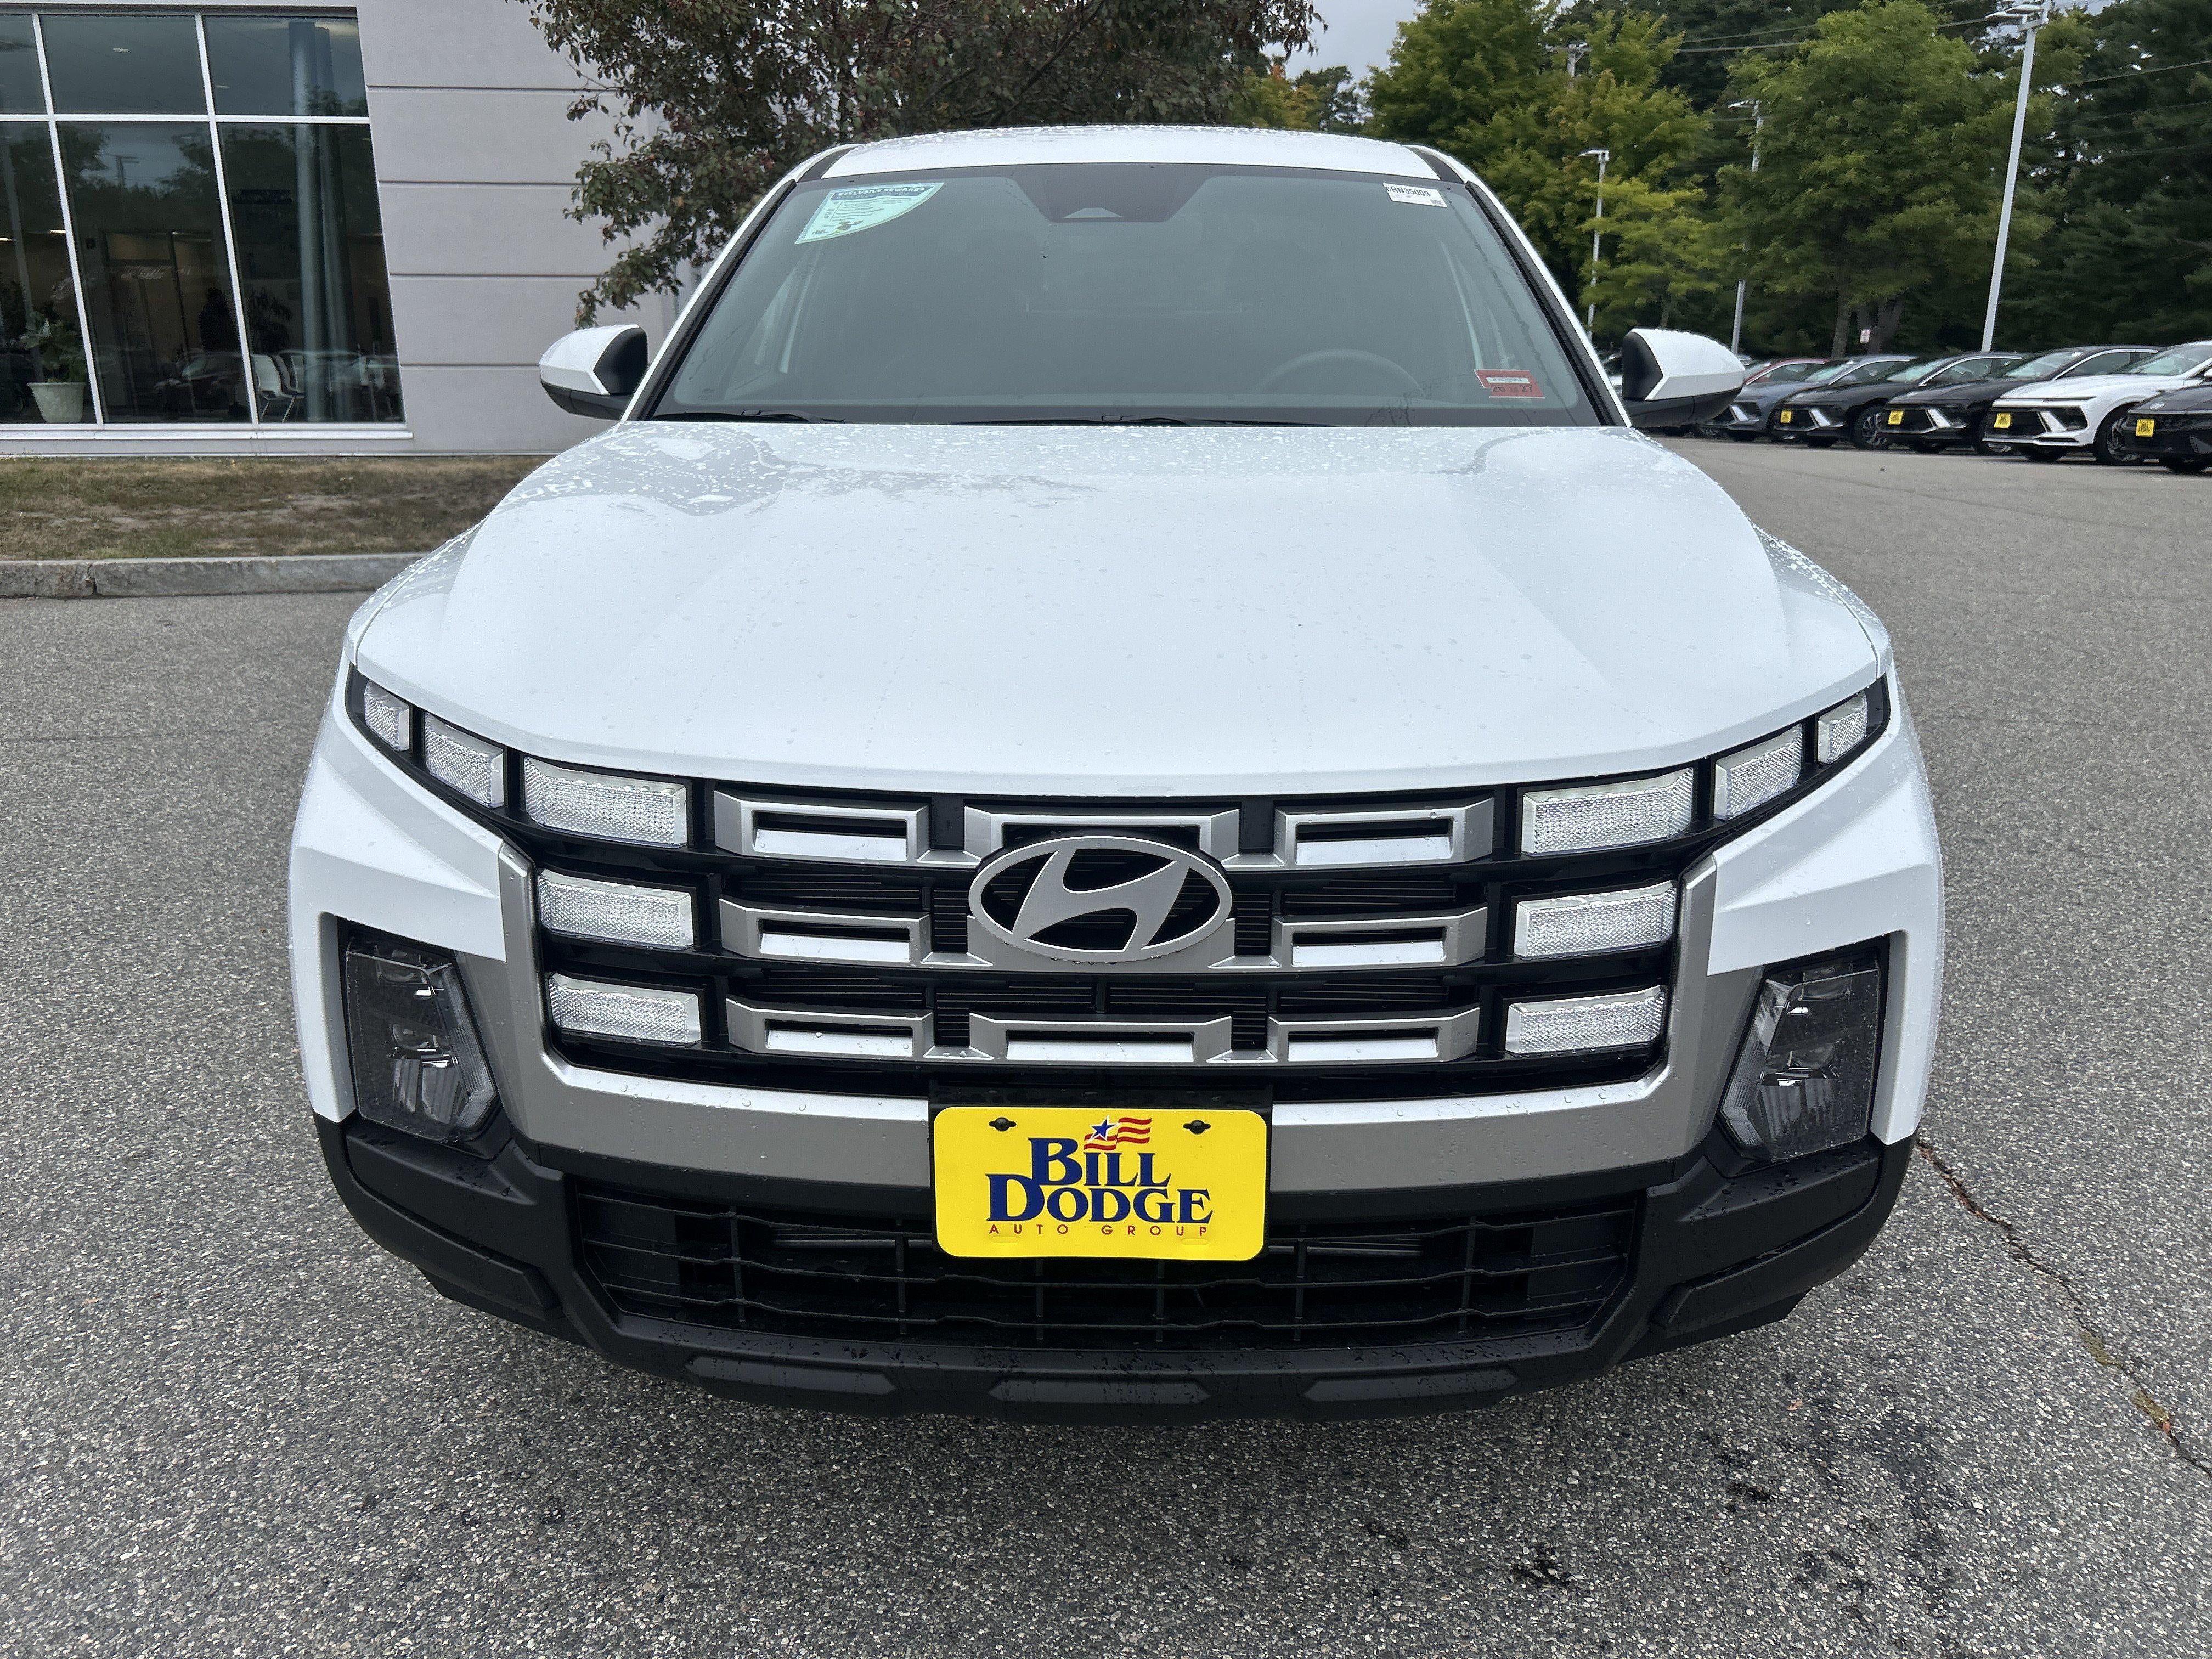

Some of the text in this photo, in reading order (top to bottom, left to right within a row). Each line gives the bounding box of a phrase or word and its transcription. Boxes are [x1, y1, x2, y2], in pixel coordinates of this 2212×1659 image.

[838, 188, 881, 196] EXCLUSIVE
[1028, 1138, 1171, 1187] BILL
[986, 1173, 1213, 1223] DODGE
[989, 1224, 1207, 1236] AUTO GROUP
